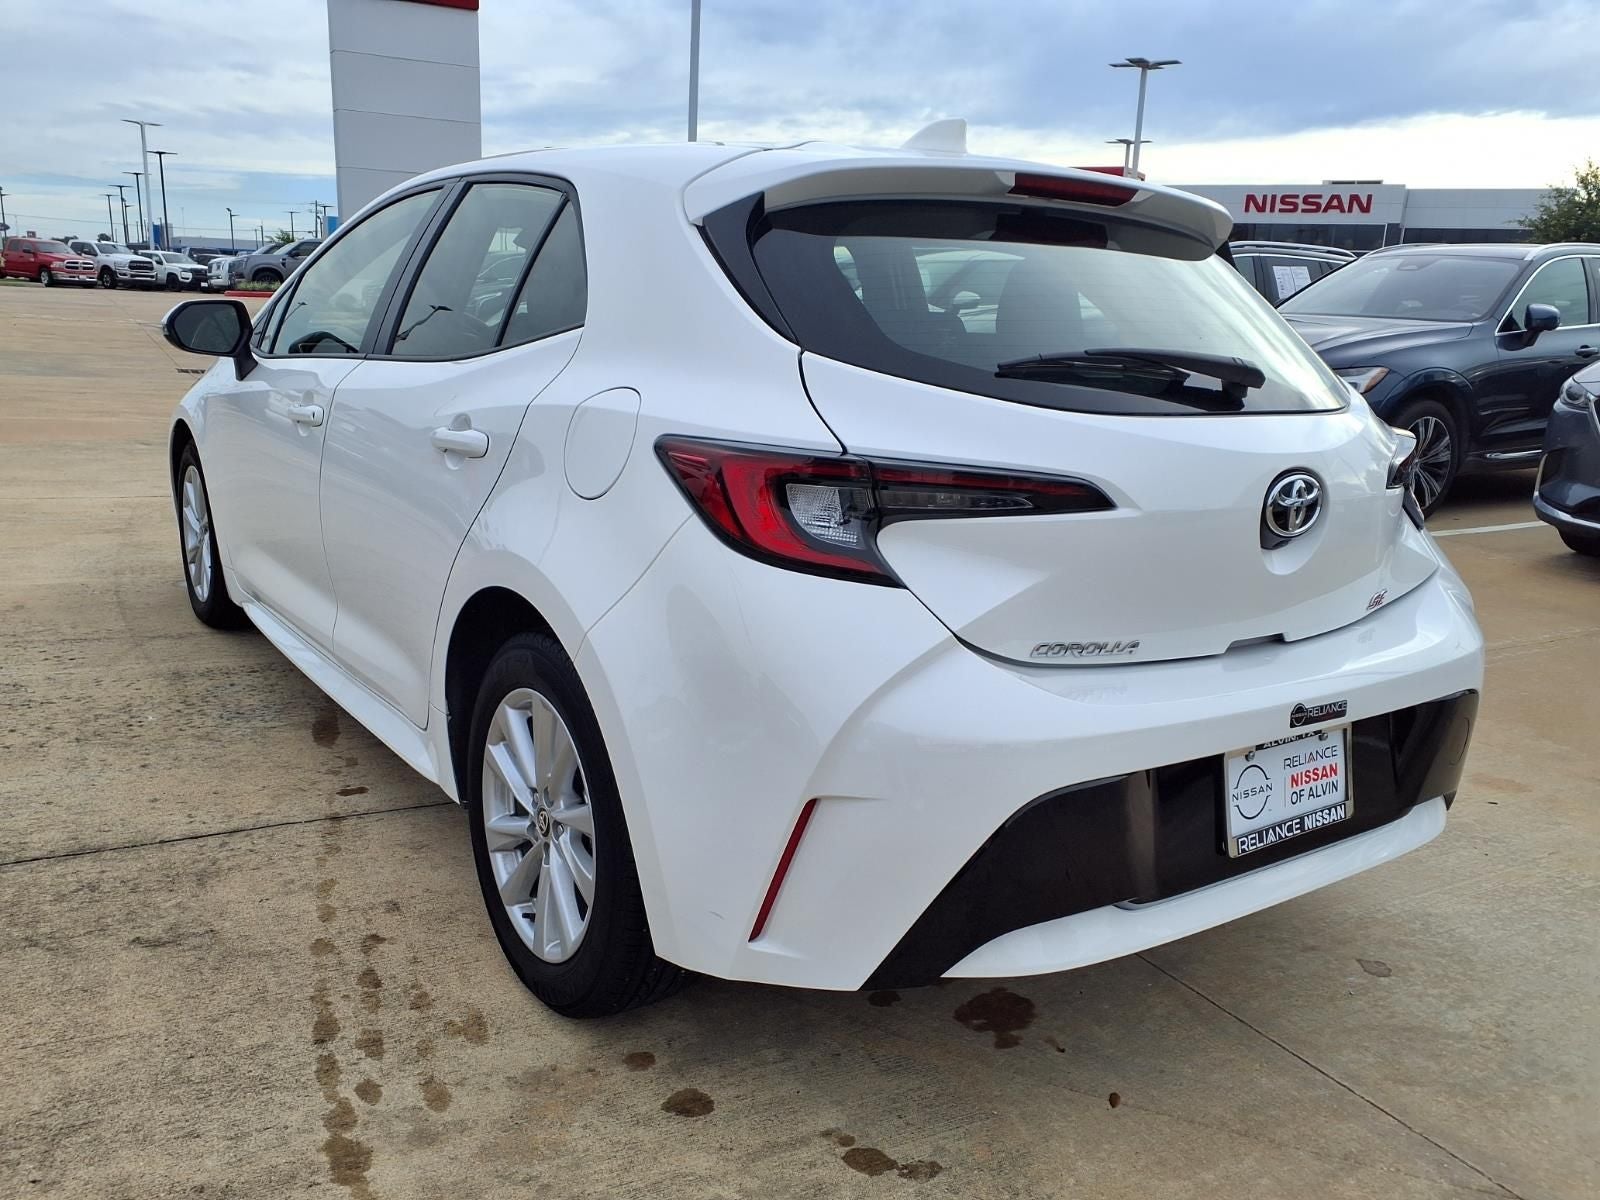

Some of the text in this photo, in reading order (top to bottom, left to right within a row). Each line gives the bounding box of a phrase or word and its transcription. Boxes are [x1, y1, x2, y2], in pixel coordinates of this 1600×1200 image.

[1244, 193, 1373, 213] NISSAN
[1030, 640, 1140, 658] COROLLA
[1307, 701, 1347, 718] RELIANCE
[1283, 745, 1338, 770] RELIANCE
[1290, 762, 1338, 789] NISSAN
[1232, 782, 1273, 802] NISSAN
[1290, 779, 1339, 805] OF ALVIN
[1238, 804, 1345, 855] RELIANCE NISSAN
